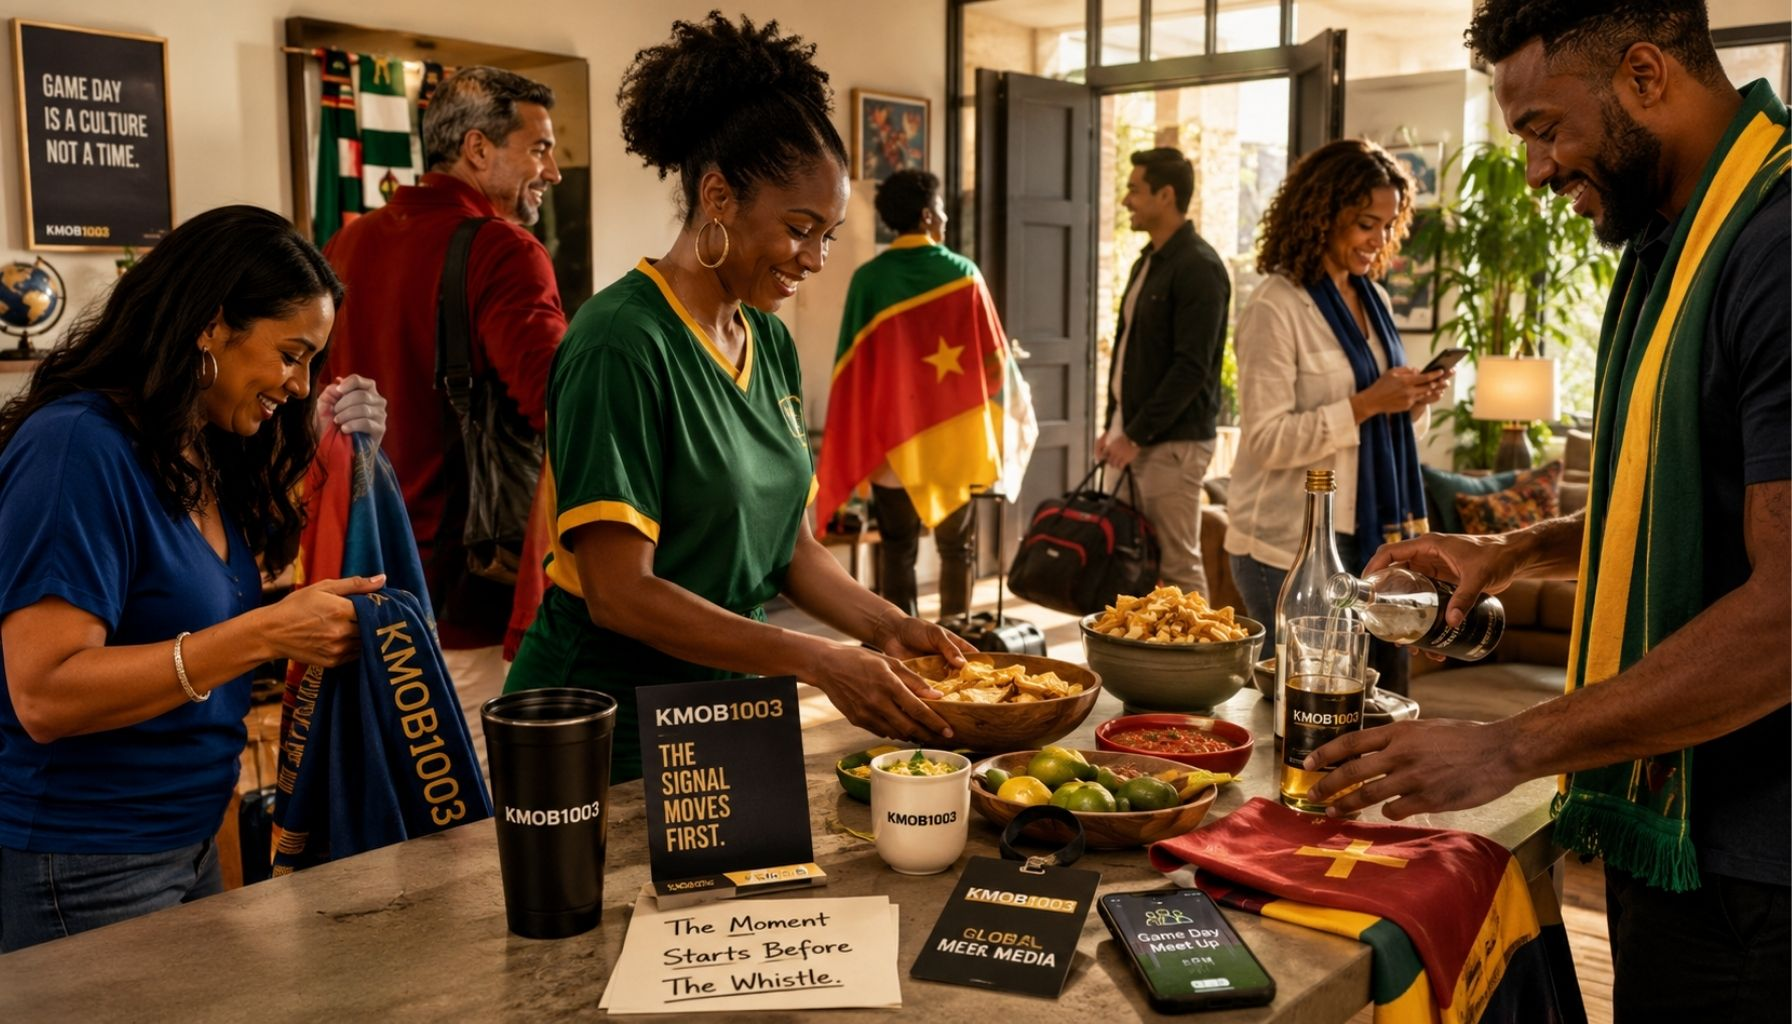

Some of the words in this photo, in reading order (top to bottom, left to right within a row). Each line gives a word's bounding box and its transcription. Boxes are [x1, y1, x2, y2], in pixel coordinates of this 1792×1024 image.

[42, 73, 88, 100] GAME
[91, 78, 122, 103] DAY
[44, 106, 60, 131] IS
[65, 108, 76, 132] A
[79, 109, 148, 138] CULTURE
[46, 139, 78, 165] NOT
[82, 142, 94, 166] A
[96, 142, 140, 168] TIME.
[46, 225, 110, 238] KMOB1003
[376, 620, 466, 826] KMOB1003
[655, 699, 784, 727] KMOB1003
[1293, 709, 1359, 725] KMOB1003
[658, 742, 696, 768] THE
[661, 767, 731, 795] SIGNAL
[505, 801, 600, 826] KMOB1003
[663, 794, 731, 824] MOVES
[887, 811, 957, 826] KMOB1003
[666, 823, 726, 852] FIRST.
[966, 887, 1076, 911] KMOB1003
[663, 917, 716, 936] The
[728, 912, 831, 933] Moment
[1137, 932, 1186, 943] Game
[1188, 928, 1220, 938] Day
[963, 927, 1043, 949] GLOBAL
[1150, 940, 1194, 953] Meet
[1195, 938, 1220, 950] Up
[663, 946, 751, 966] Starts
[762, 939, 853, 961] Before
[993, 947, 1056, 968] MEDIA
[661, 975, 717, 996] The
[730, 968, 842, 992] Whistle.
